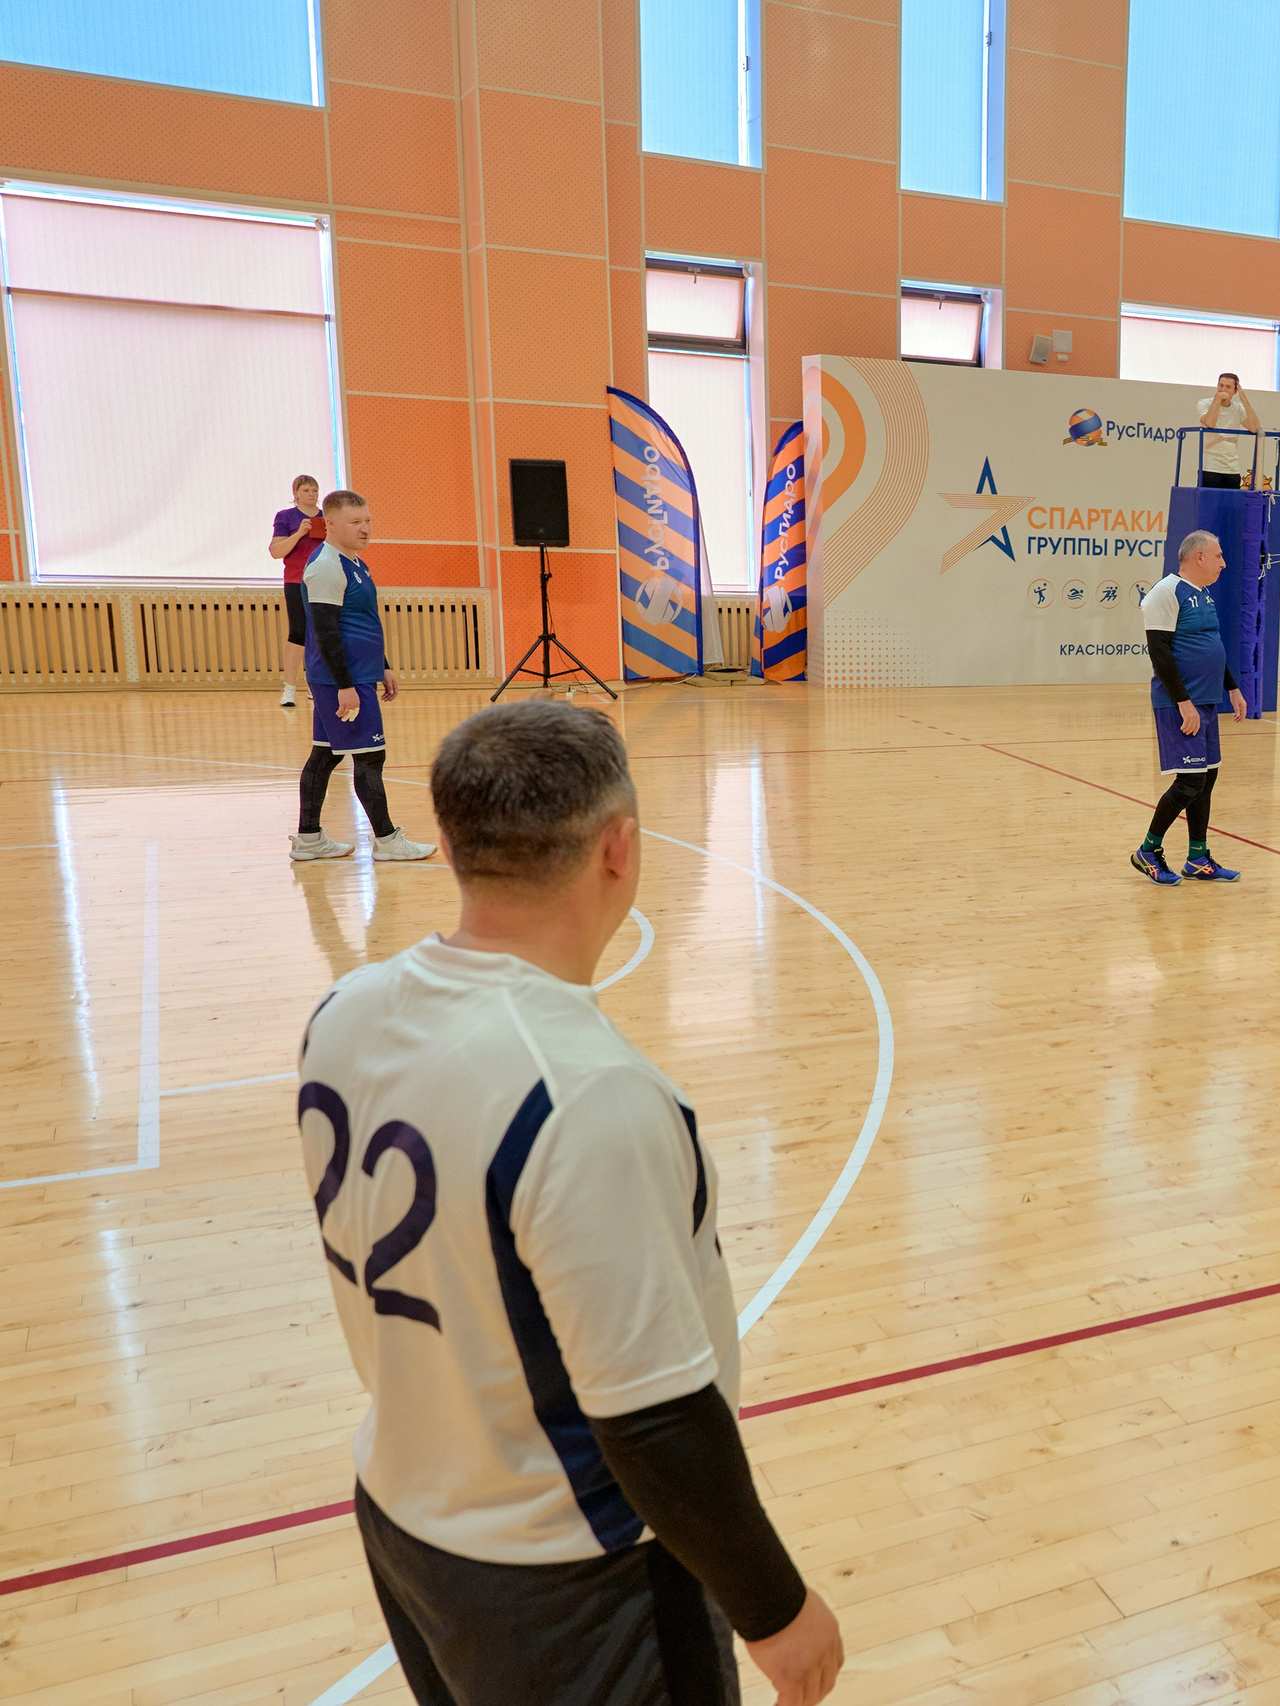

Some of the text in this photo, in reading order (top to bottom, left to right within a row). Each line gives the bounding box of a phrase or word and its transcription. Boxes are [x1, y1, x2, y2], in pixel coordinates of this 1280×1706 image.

[1106, 420, 1187, 443] РусГидро
[1027, 506, 1167, 533] СПАРТАКИ
[1027, 536, 1165, 557] ГРУППЫ РУСГ
[353, 571, 362, 583] 8
[1060, 644, 1149, 656] КРАСНОЯРСК
[298, 1081, 441, 1334] 22
